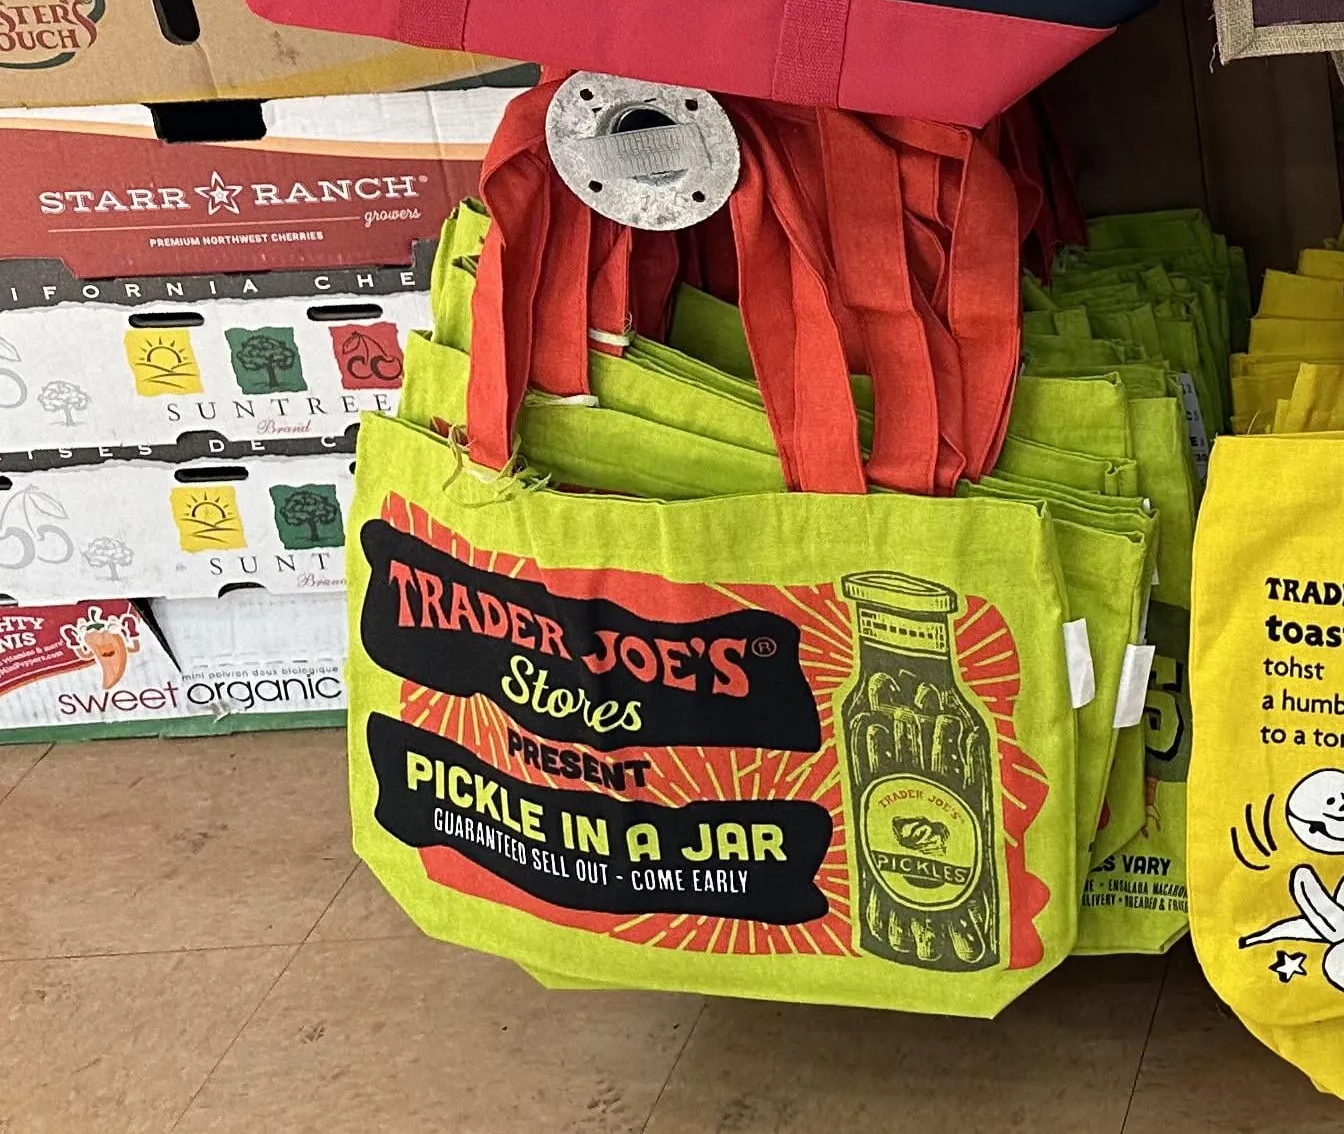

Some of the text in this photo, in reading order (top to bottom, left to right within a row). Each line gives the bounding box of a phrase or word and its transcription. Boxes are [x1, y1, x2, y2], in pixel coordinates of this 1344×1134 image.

[0, 30, 81, 52] OUCH
[38, 174, 419, 215] STARR RANCH
[364, 207, 421, 228] growers
[149, 231, 325, 248] PREMIUM NORTHWEST CHERRIES
[11, 270, 417, 302] IFORNIA CHE
[167, 392, 393, 422] SUNTREE
[257, 419, 312, 435] Brand
[209, 552, 330, 575] SUNT
[388, 559, 574, 661] TRADER
[1264, 657, 1324, 680] tohst
[59, 674, 342, 715] sweet organic
[501, 654, 643, 733] Stores
[1261, 693, 1274, 711] a
[1260, 725, 1287, 745] to
[1293, 728, 1306, 745] a
[507, 724, 652, 792] PRESENT
[406, 750, 787, 862] PICKLE IN A JAR
[878, 790, 923, 809] TRADER
[433, 808, 527, 866] GUARANTEED
[531, 848, 570, 879] SELL
[575, 862, 610, 887] OUT
[631, 868, 686, 893] COME
[692, 869, 749, 895] EARLY
[877, 854, 968, 884] PICKLES
[1122, 854, 1171, 877] VARY
